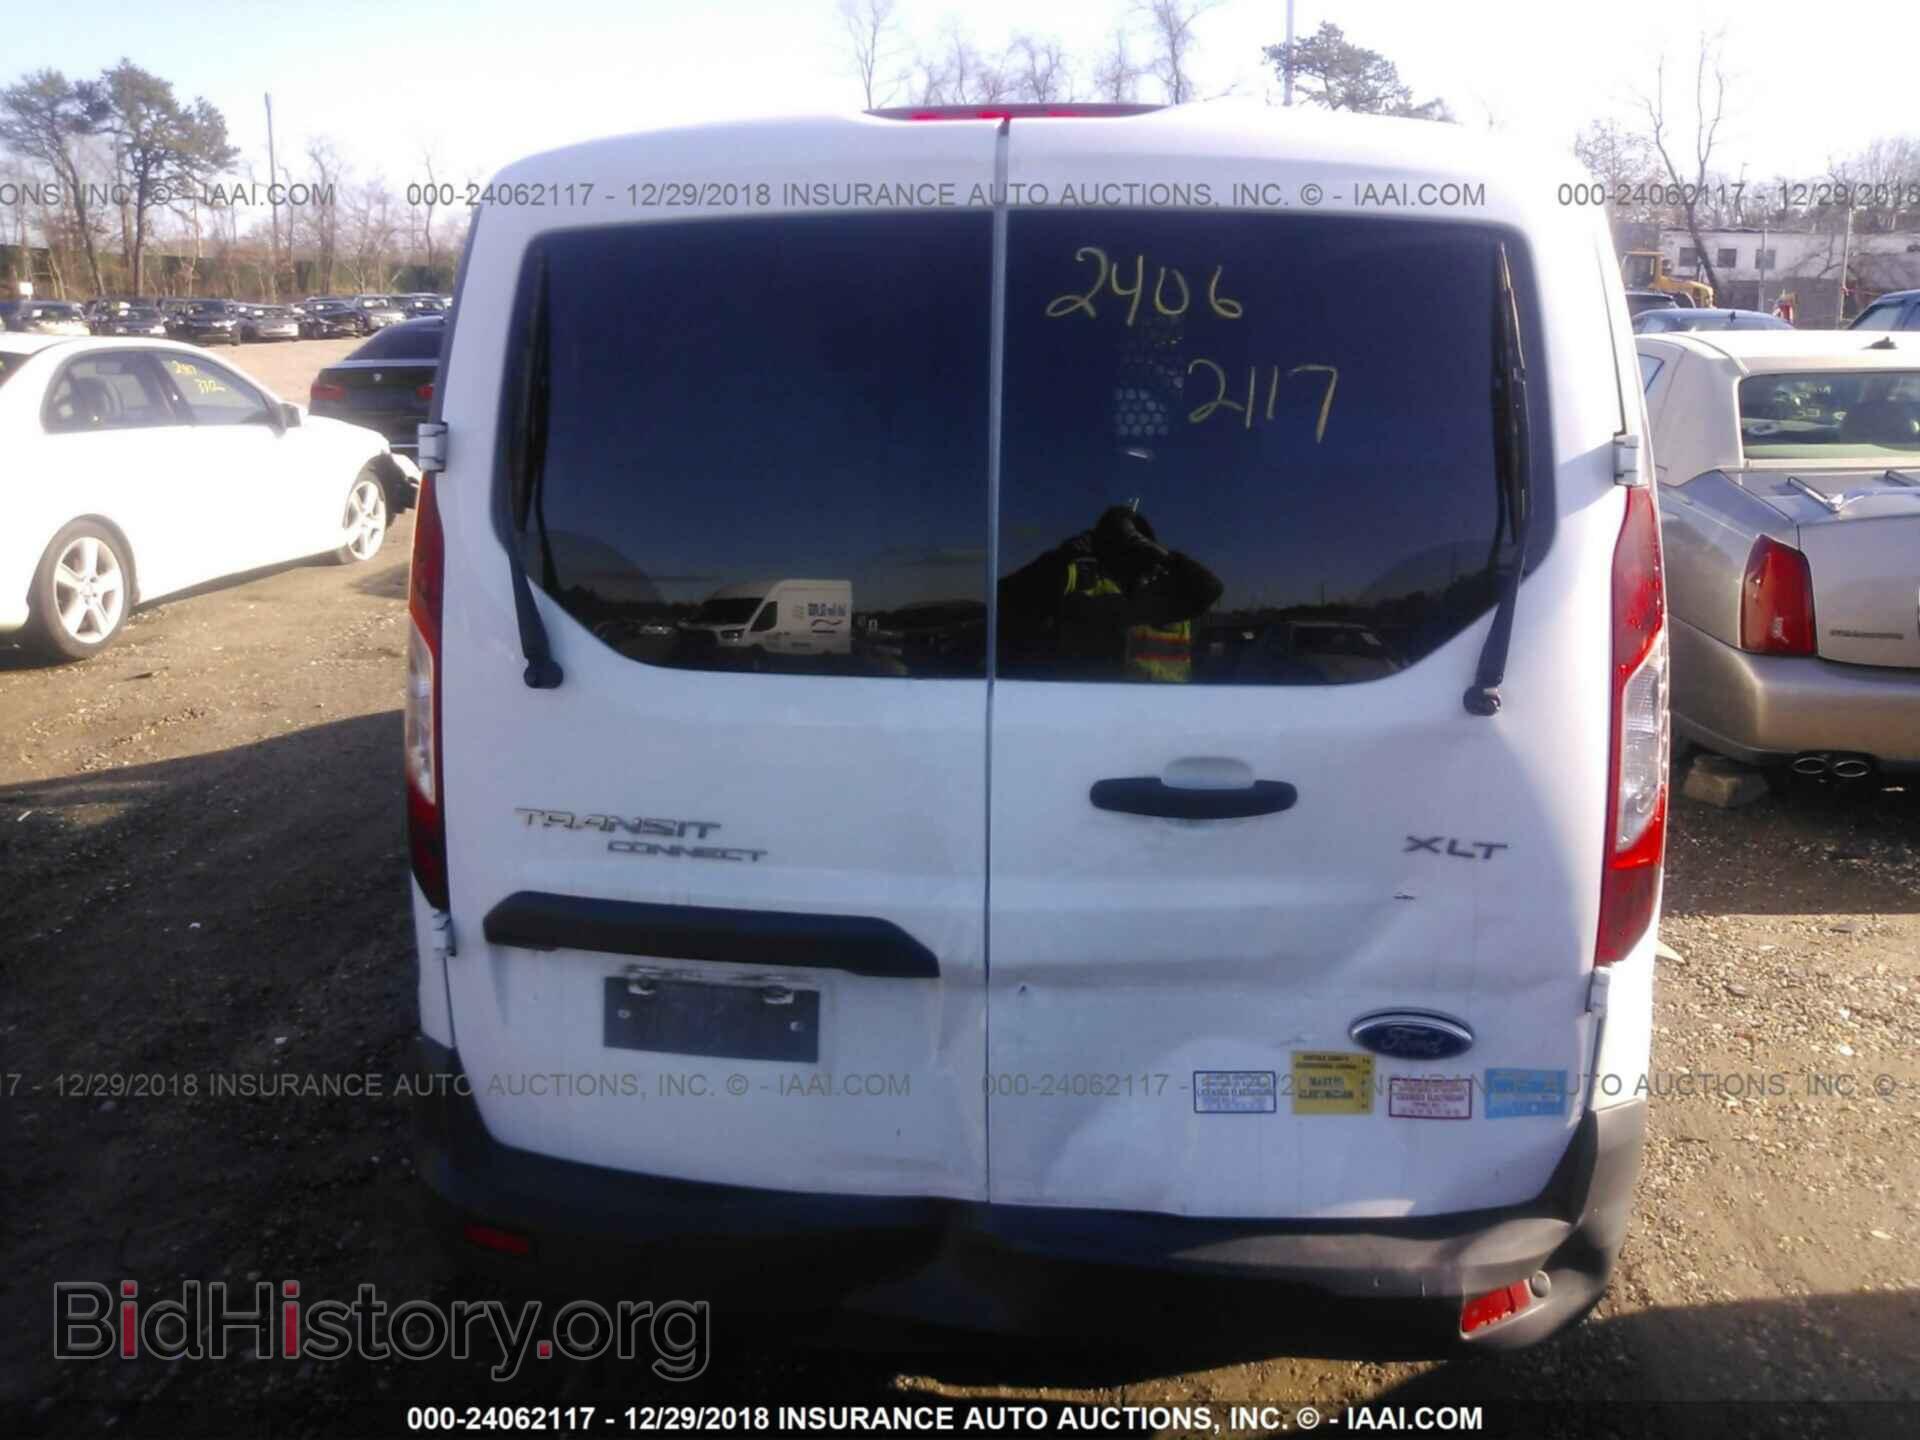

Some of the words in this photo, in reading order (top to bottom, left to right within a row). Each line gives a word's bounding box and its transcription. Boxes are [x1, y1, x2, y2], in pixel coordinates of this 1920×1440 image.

[1046, 246, 1244, 326] 2406
[1188, 358, 1338, 443] 2117
[515, 808, 722, 839] TRANSIT
[607, 840, 768, 862] CONNECT
[1402, 835, 1509, 860] XLT
